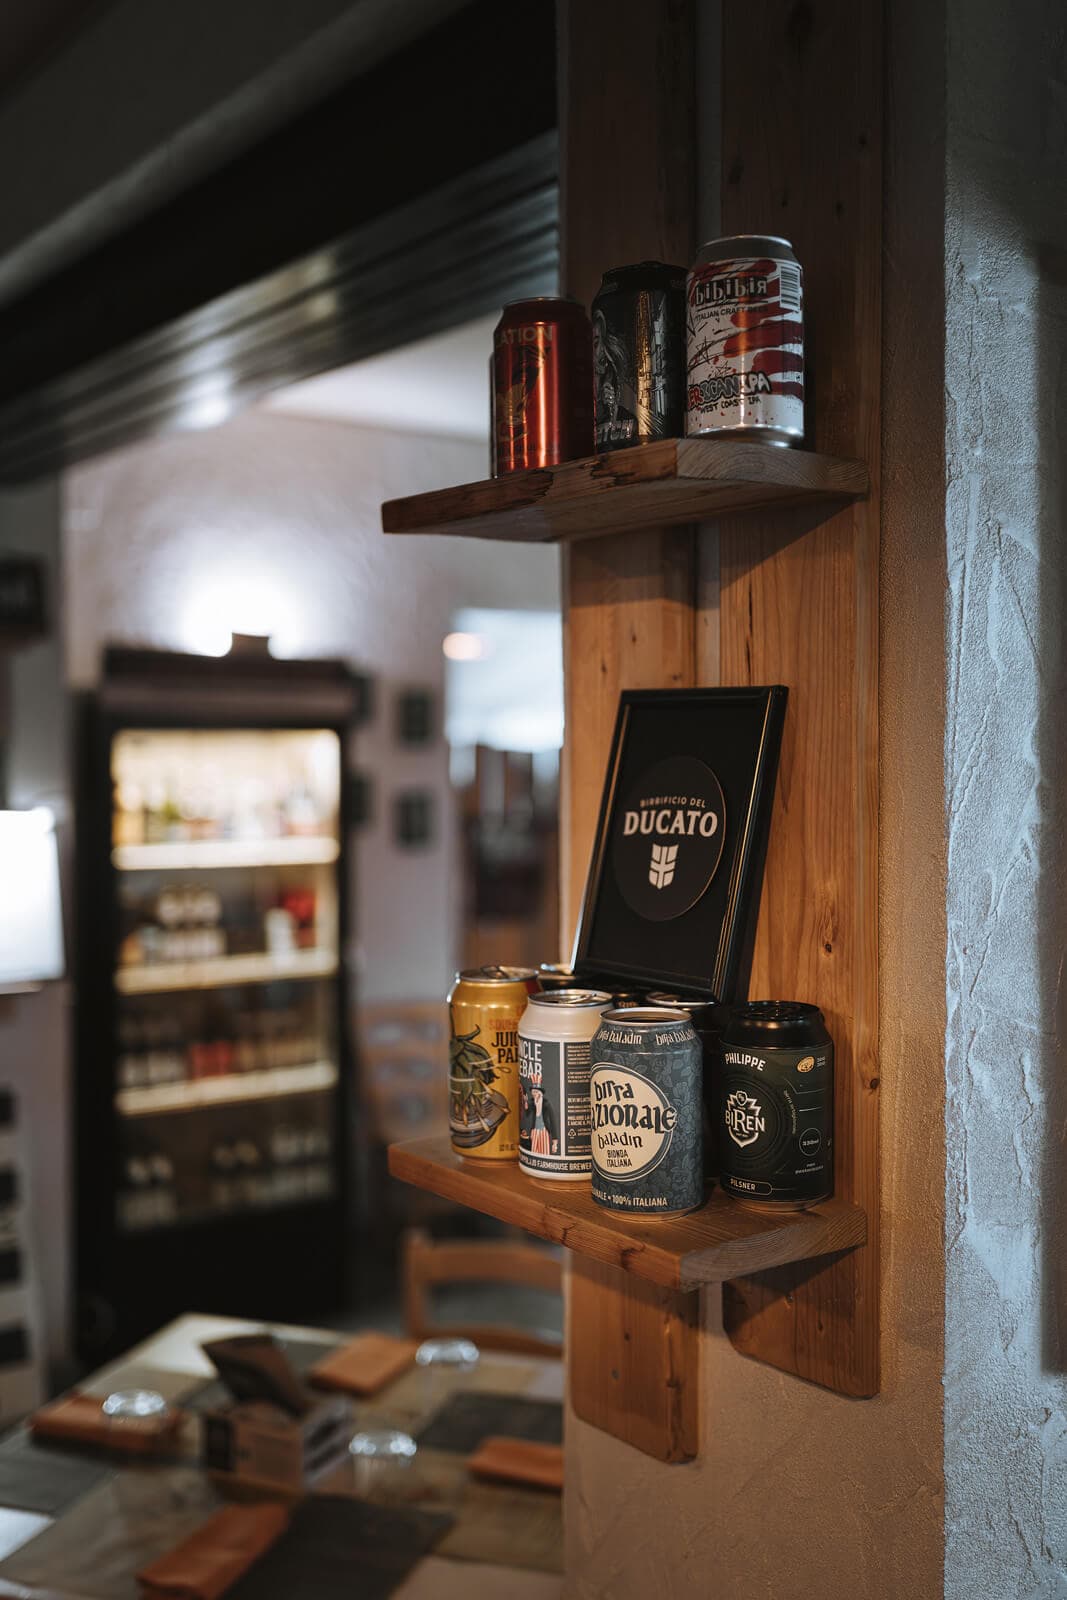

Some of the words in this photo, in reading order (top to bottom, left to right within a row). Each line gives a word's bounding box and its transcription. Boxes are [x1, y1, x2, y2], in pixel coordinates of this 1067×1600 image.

[694, 310, 719, 322] ITALIAN
[690, 798, 706, 808] DEL
[623, 810, 718, 837] DUCATO
[725, 1052, 766, 1072] PHILIPPE
[594, 1080, 634, 1102] birra
[598, 1132, 643, 1150] baladin
[607, 1149, 629, 1159] BIONDA
[606, 1159, 633, 1168] ITALIANA
[730, 1178, 756, 1191] PILSNER
[632, 1197, 668, 1207] ITALIANA
